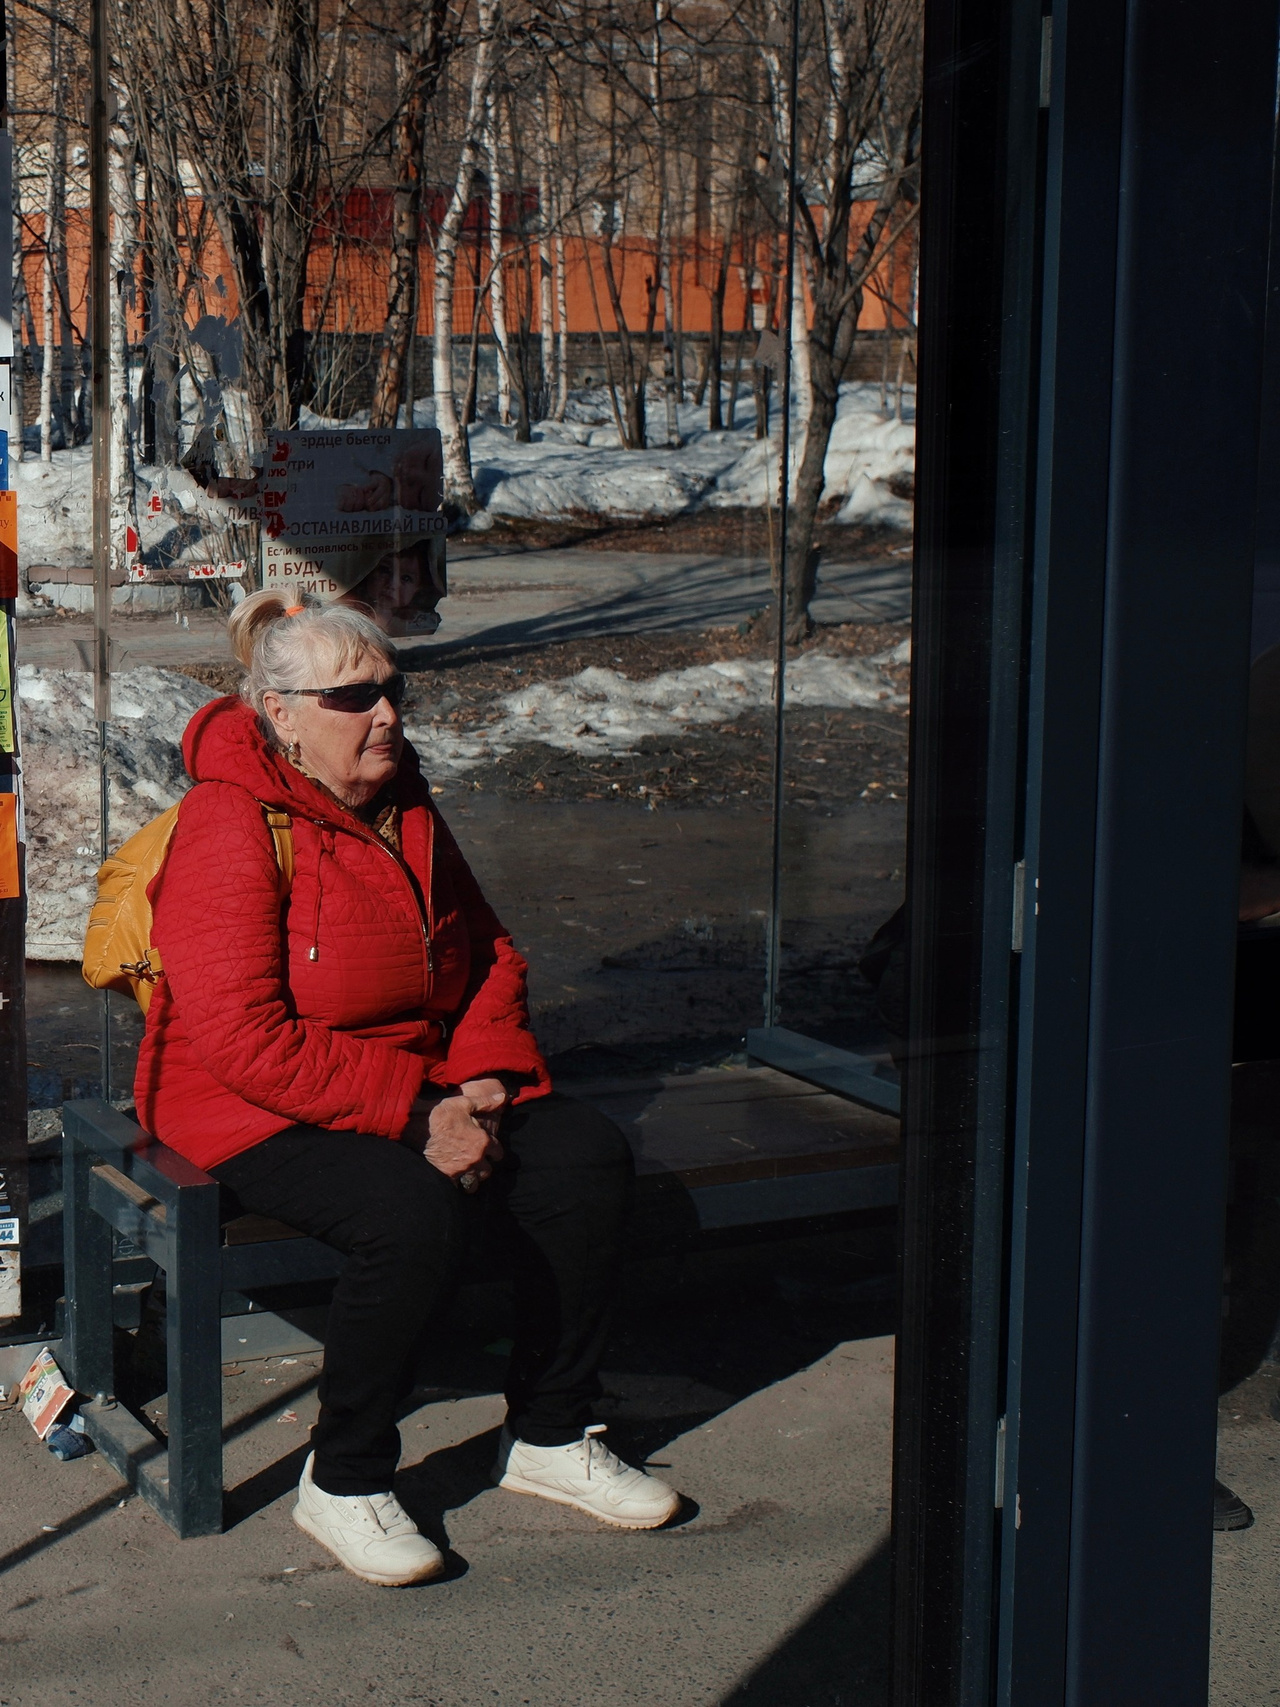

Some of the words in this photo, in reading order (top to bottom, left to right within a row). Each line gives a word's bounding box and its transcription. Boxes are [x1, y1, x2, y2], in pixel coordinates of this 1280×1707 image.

[345, 433, 392, 446] бьется
[420, 515, 446, 531] ЕГО
[304, 541, 358, 556] появлюсь
[268, 563, 277, 576] Я
[284, 559, 324, 578] БУДУ
